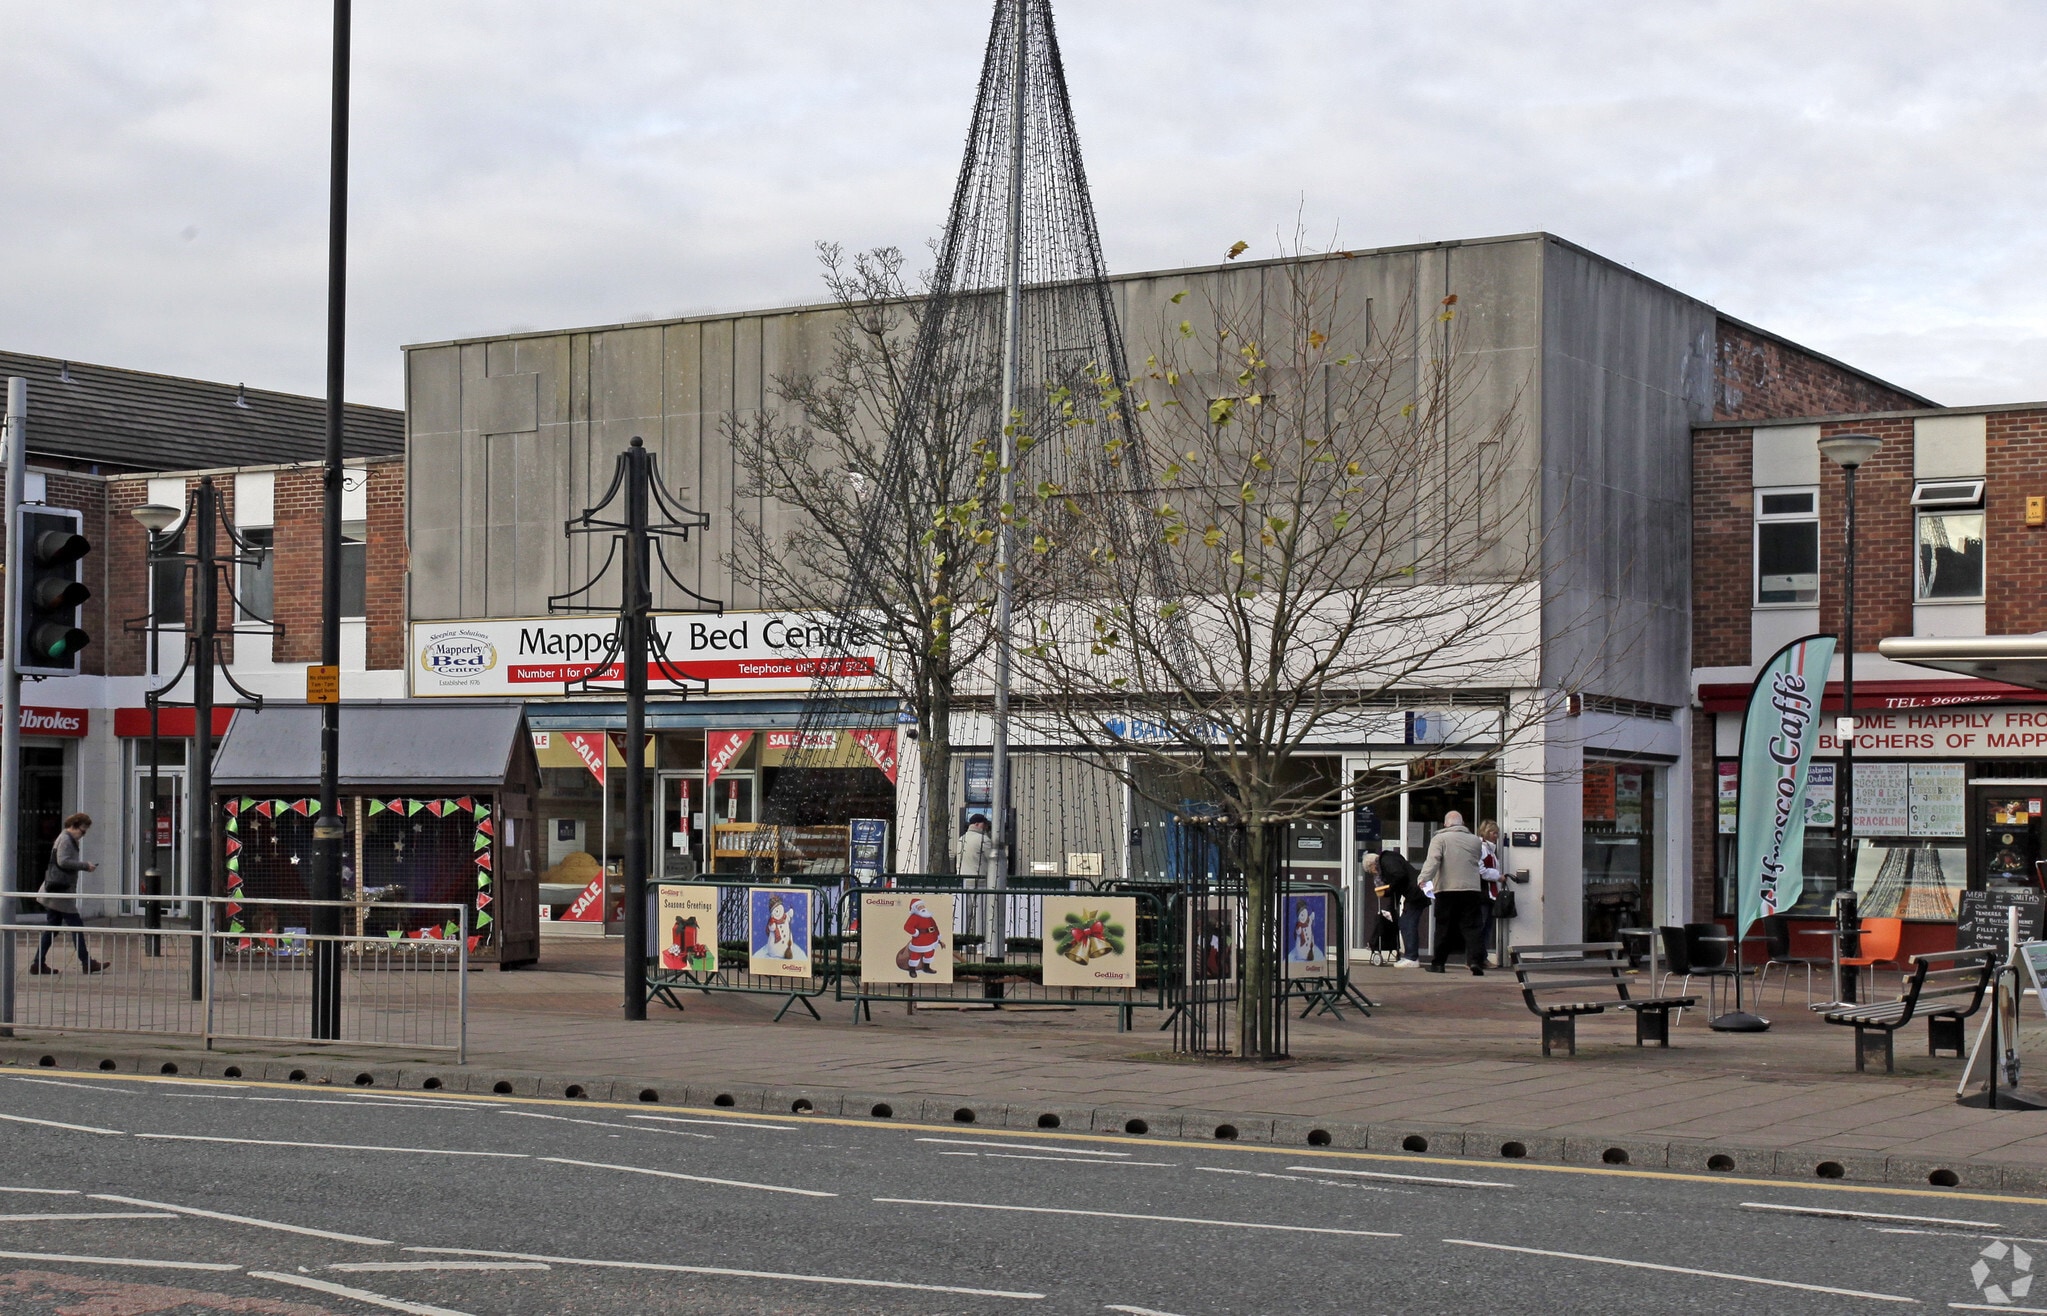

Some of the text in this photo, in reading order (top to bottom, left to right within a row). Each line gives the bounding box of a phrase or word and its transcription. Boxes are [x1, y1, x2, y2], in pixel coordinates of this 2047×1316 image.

[430, 629, 489, 641] Sleeping Solutions
[518, 627, 673, 661] Mappey
[690, 620, 749, 650] Bed
[435, 643, 483, 655] Mapperley
[431, 655, 486, 667] Bed
[517, 669, 555, 679] Number
[559, 669, 564, 678] 1
[567, 668, 580, 678] for
[738, 663, 792, 676] Telephone
[1885, 697, 1926, 709] TEL:
[0, 709, 80, 730] dbrokes
[1769, 672, 1811, 766] Caffé
[1834, 714, 1897, 729] OME
[1908, 713, 1994, 729] HAPPILY
[769, 734, 799, 746] SALE
[803, 733, 833, 746] SALE
[1818, 732, 2047, 749] BUTCHERS OF MAPP
[571, 735, 602, 773] SALE
[711, 732, 743, 773] SALE
[859, 733, 895, 773] SALE
[1853, 816, 1907, 826] CRACKLING
[571, 881, 602, 918] SALE
[866, 898, 895, 906] Gedling
[1965, 890, 1987, 899] MEAT
[2010, 894, 2040, 902] SMITHS
[664, 898, 712, 913] Seasons Greetings
[1094, 971, 1124, 979] Gedling
